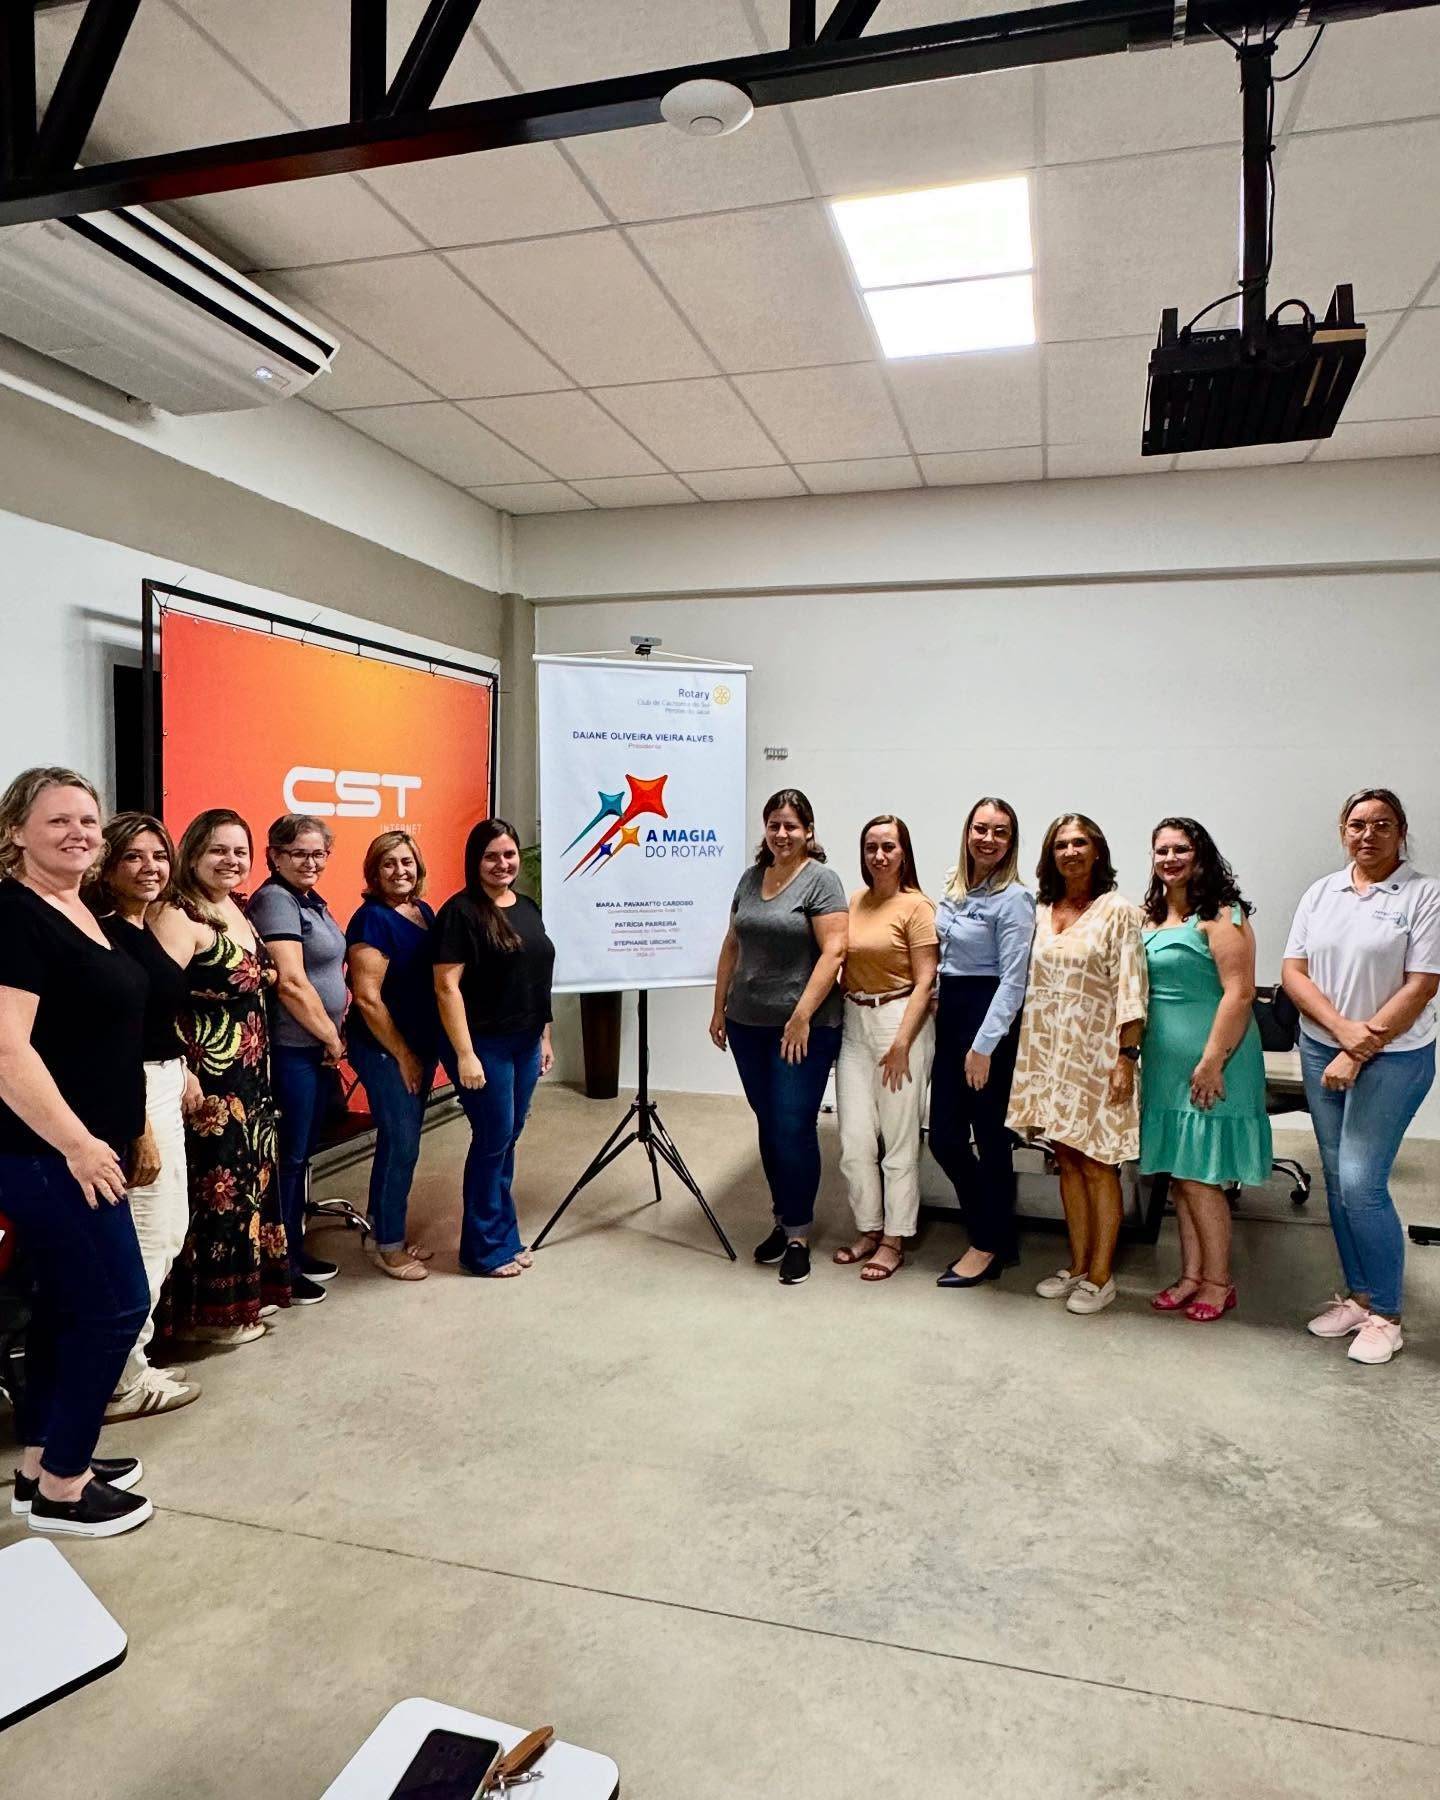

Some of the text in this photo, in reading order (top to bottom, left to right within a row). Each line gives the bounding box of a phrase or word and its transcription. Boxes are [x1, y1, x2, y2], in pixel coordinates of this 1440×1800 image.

[678, 688, 710, 701] Rotary
[572, 731, 714, 743] DAIANE OLIVEIRA VIEIRA ALVES
[283, 766, 423, 819] CST
[645, 829, 718, 842] A MAGIA
[645, 845, 725, 858] DO ROTARY
